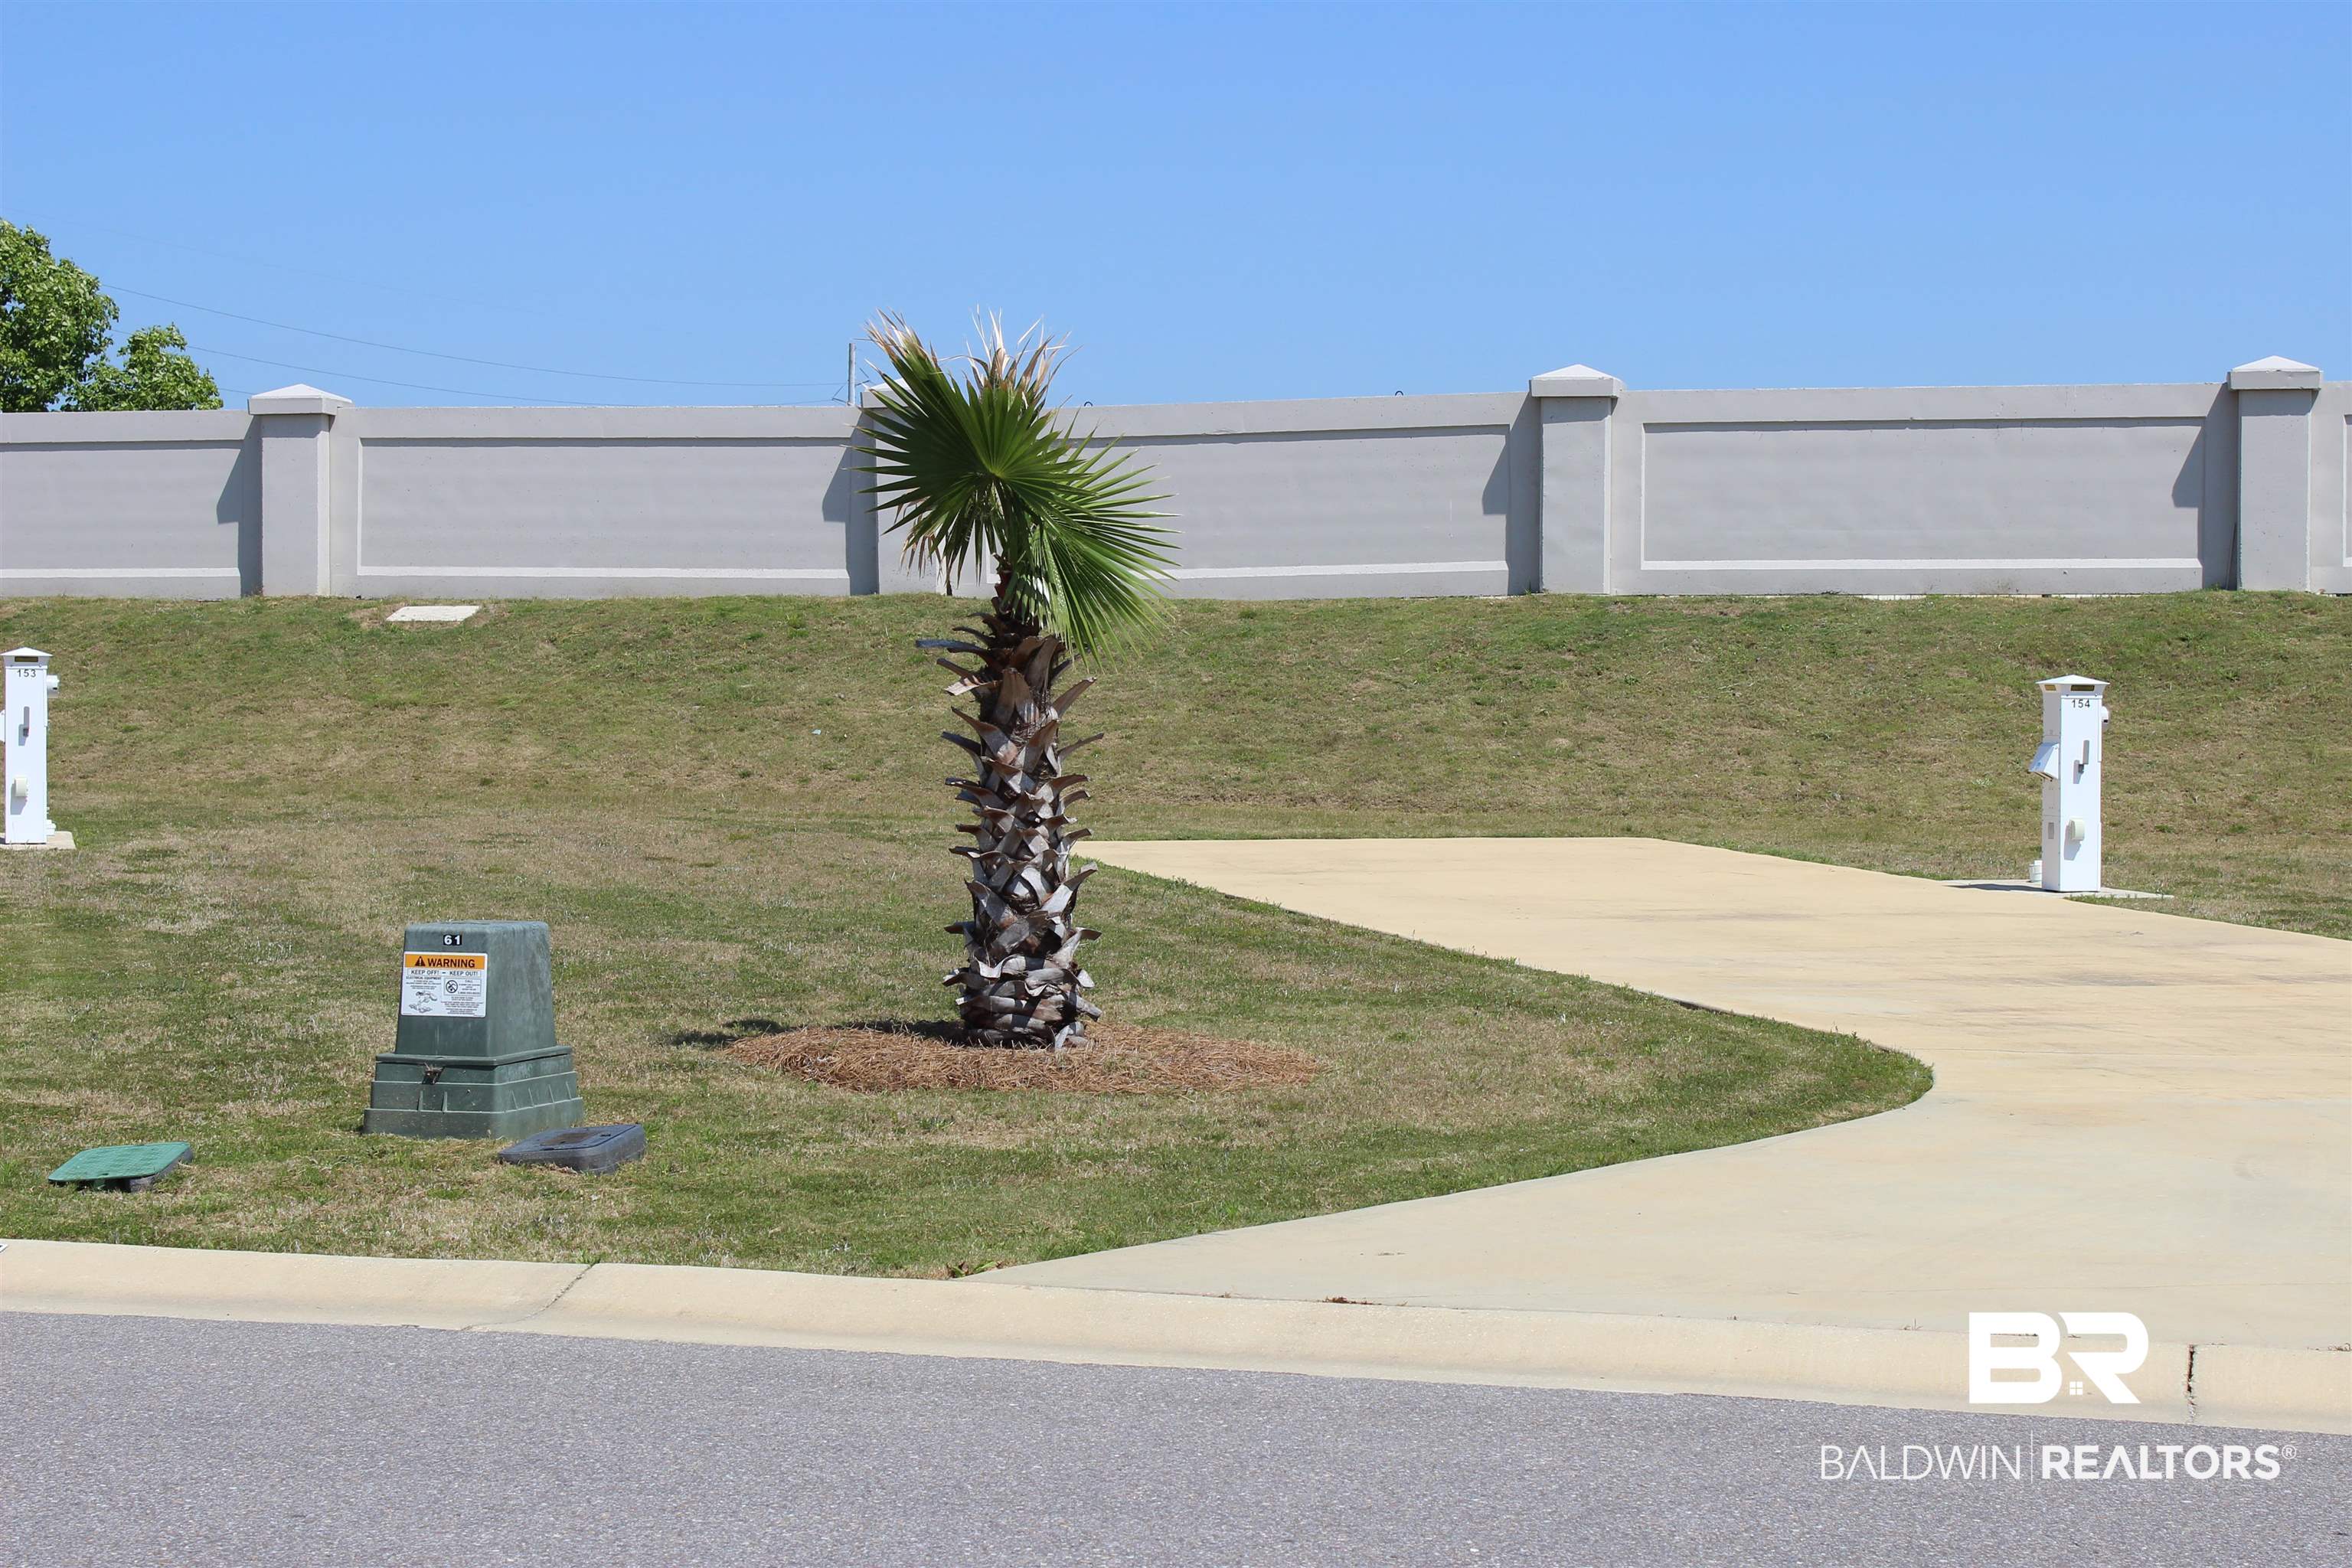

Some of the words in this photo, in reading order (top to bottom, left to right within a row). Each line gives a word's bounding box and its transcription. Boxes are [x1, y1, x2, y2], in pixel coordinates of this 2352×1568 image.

[17, 668, 37, 678] 153
[2071, 699, 2090, 708] 154
[444, 935, 460, 945] 61
[427, 958, 475, 969] WARNING
